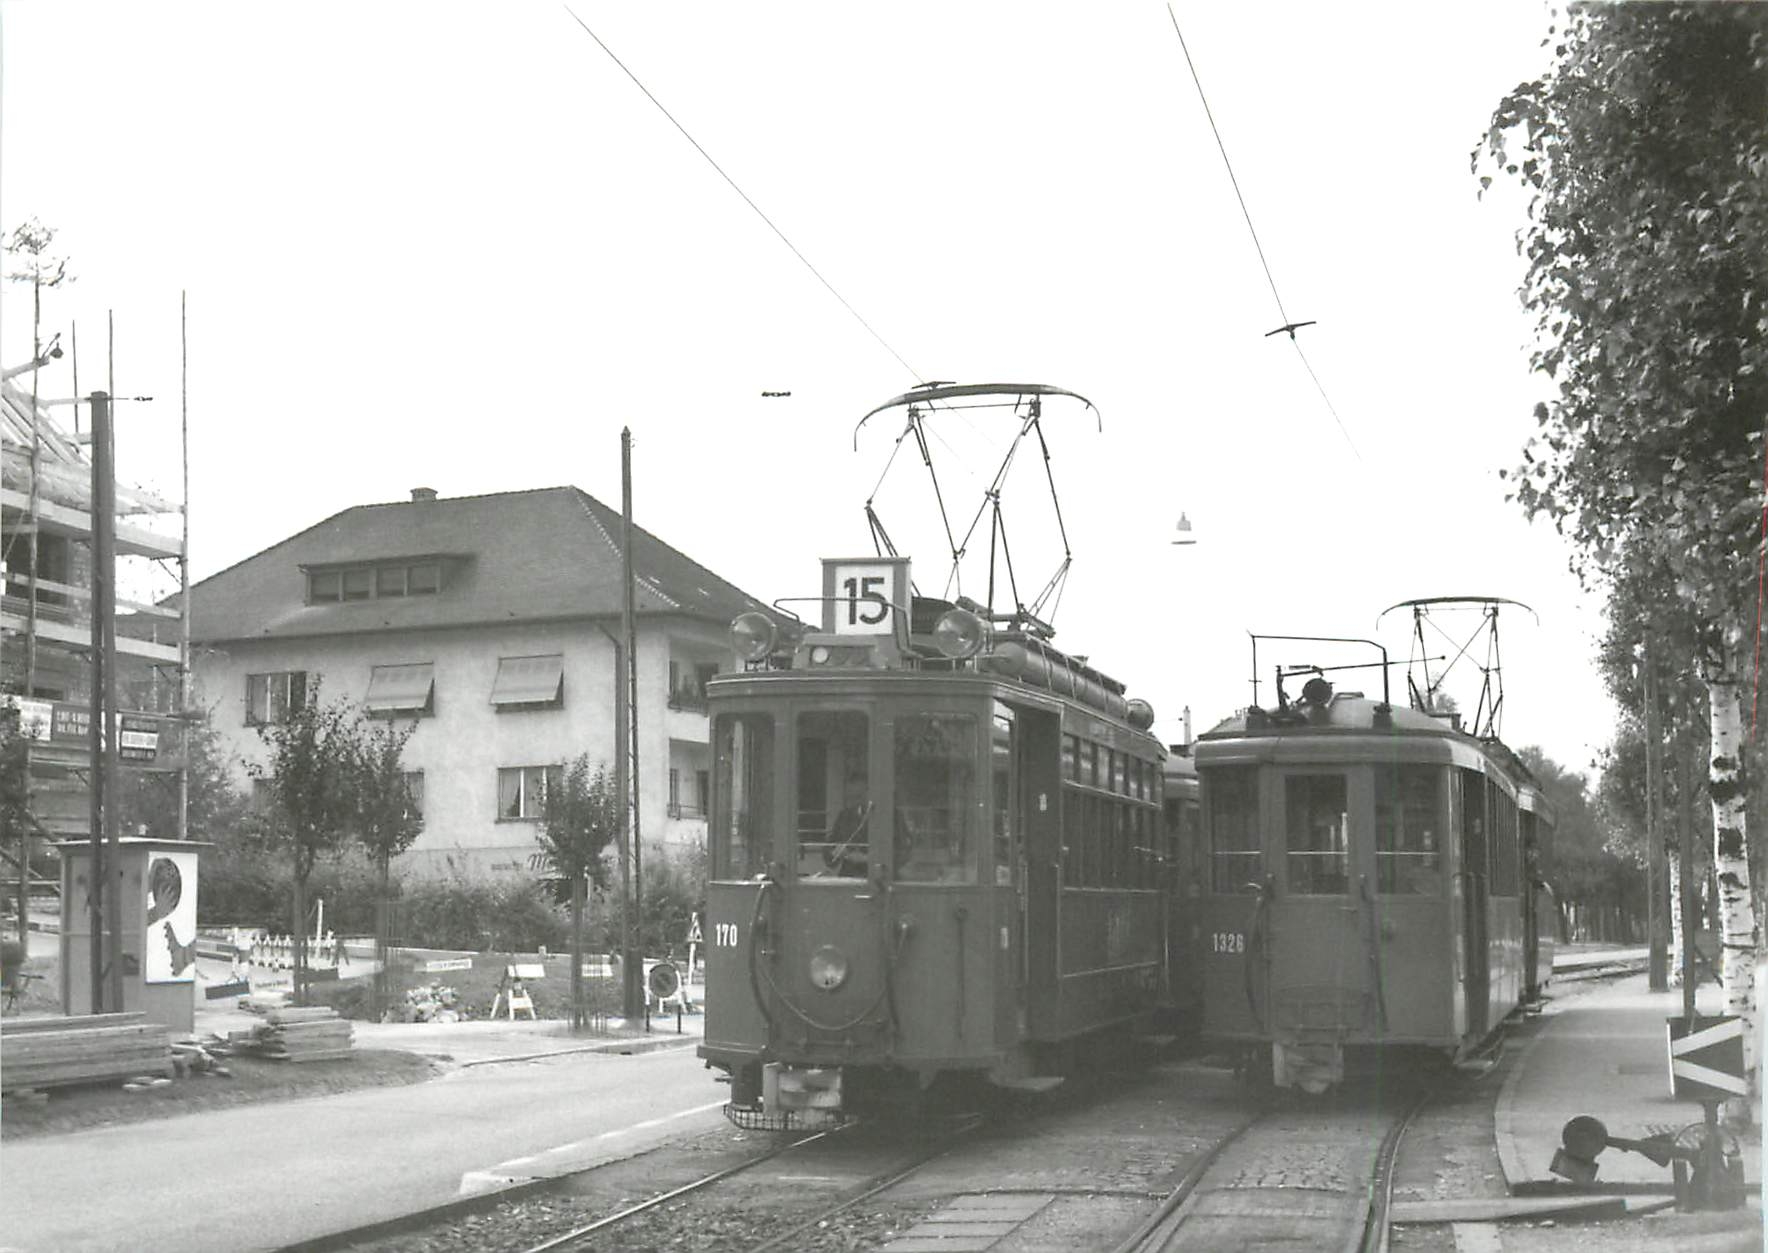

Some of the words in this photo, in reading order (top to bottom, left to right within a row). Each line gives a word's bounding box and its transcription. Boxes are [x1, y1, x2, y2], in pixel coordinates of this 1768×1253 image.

[844, 577, 888, 625] 15
[716, 923, 738, 947] 170
[1212, 932, 1244, 953] 1326
